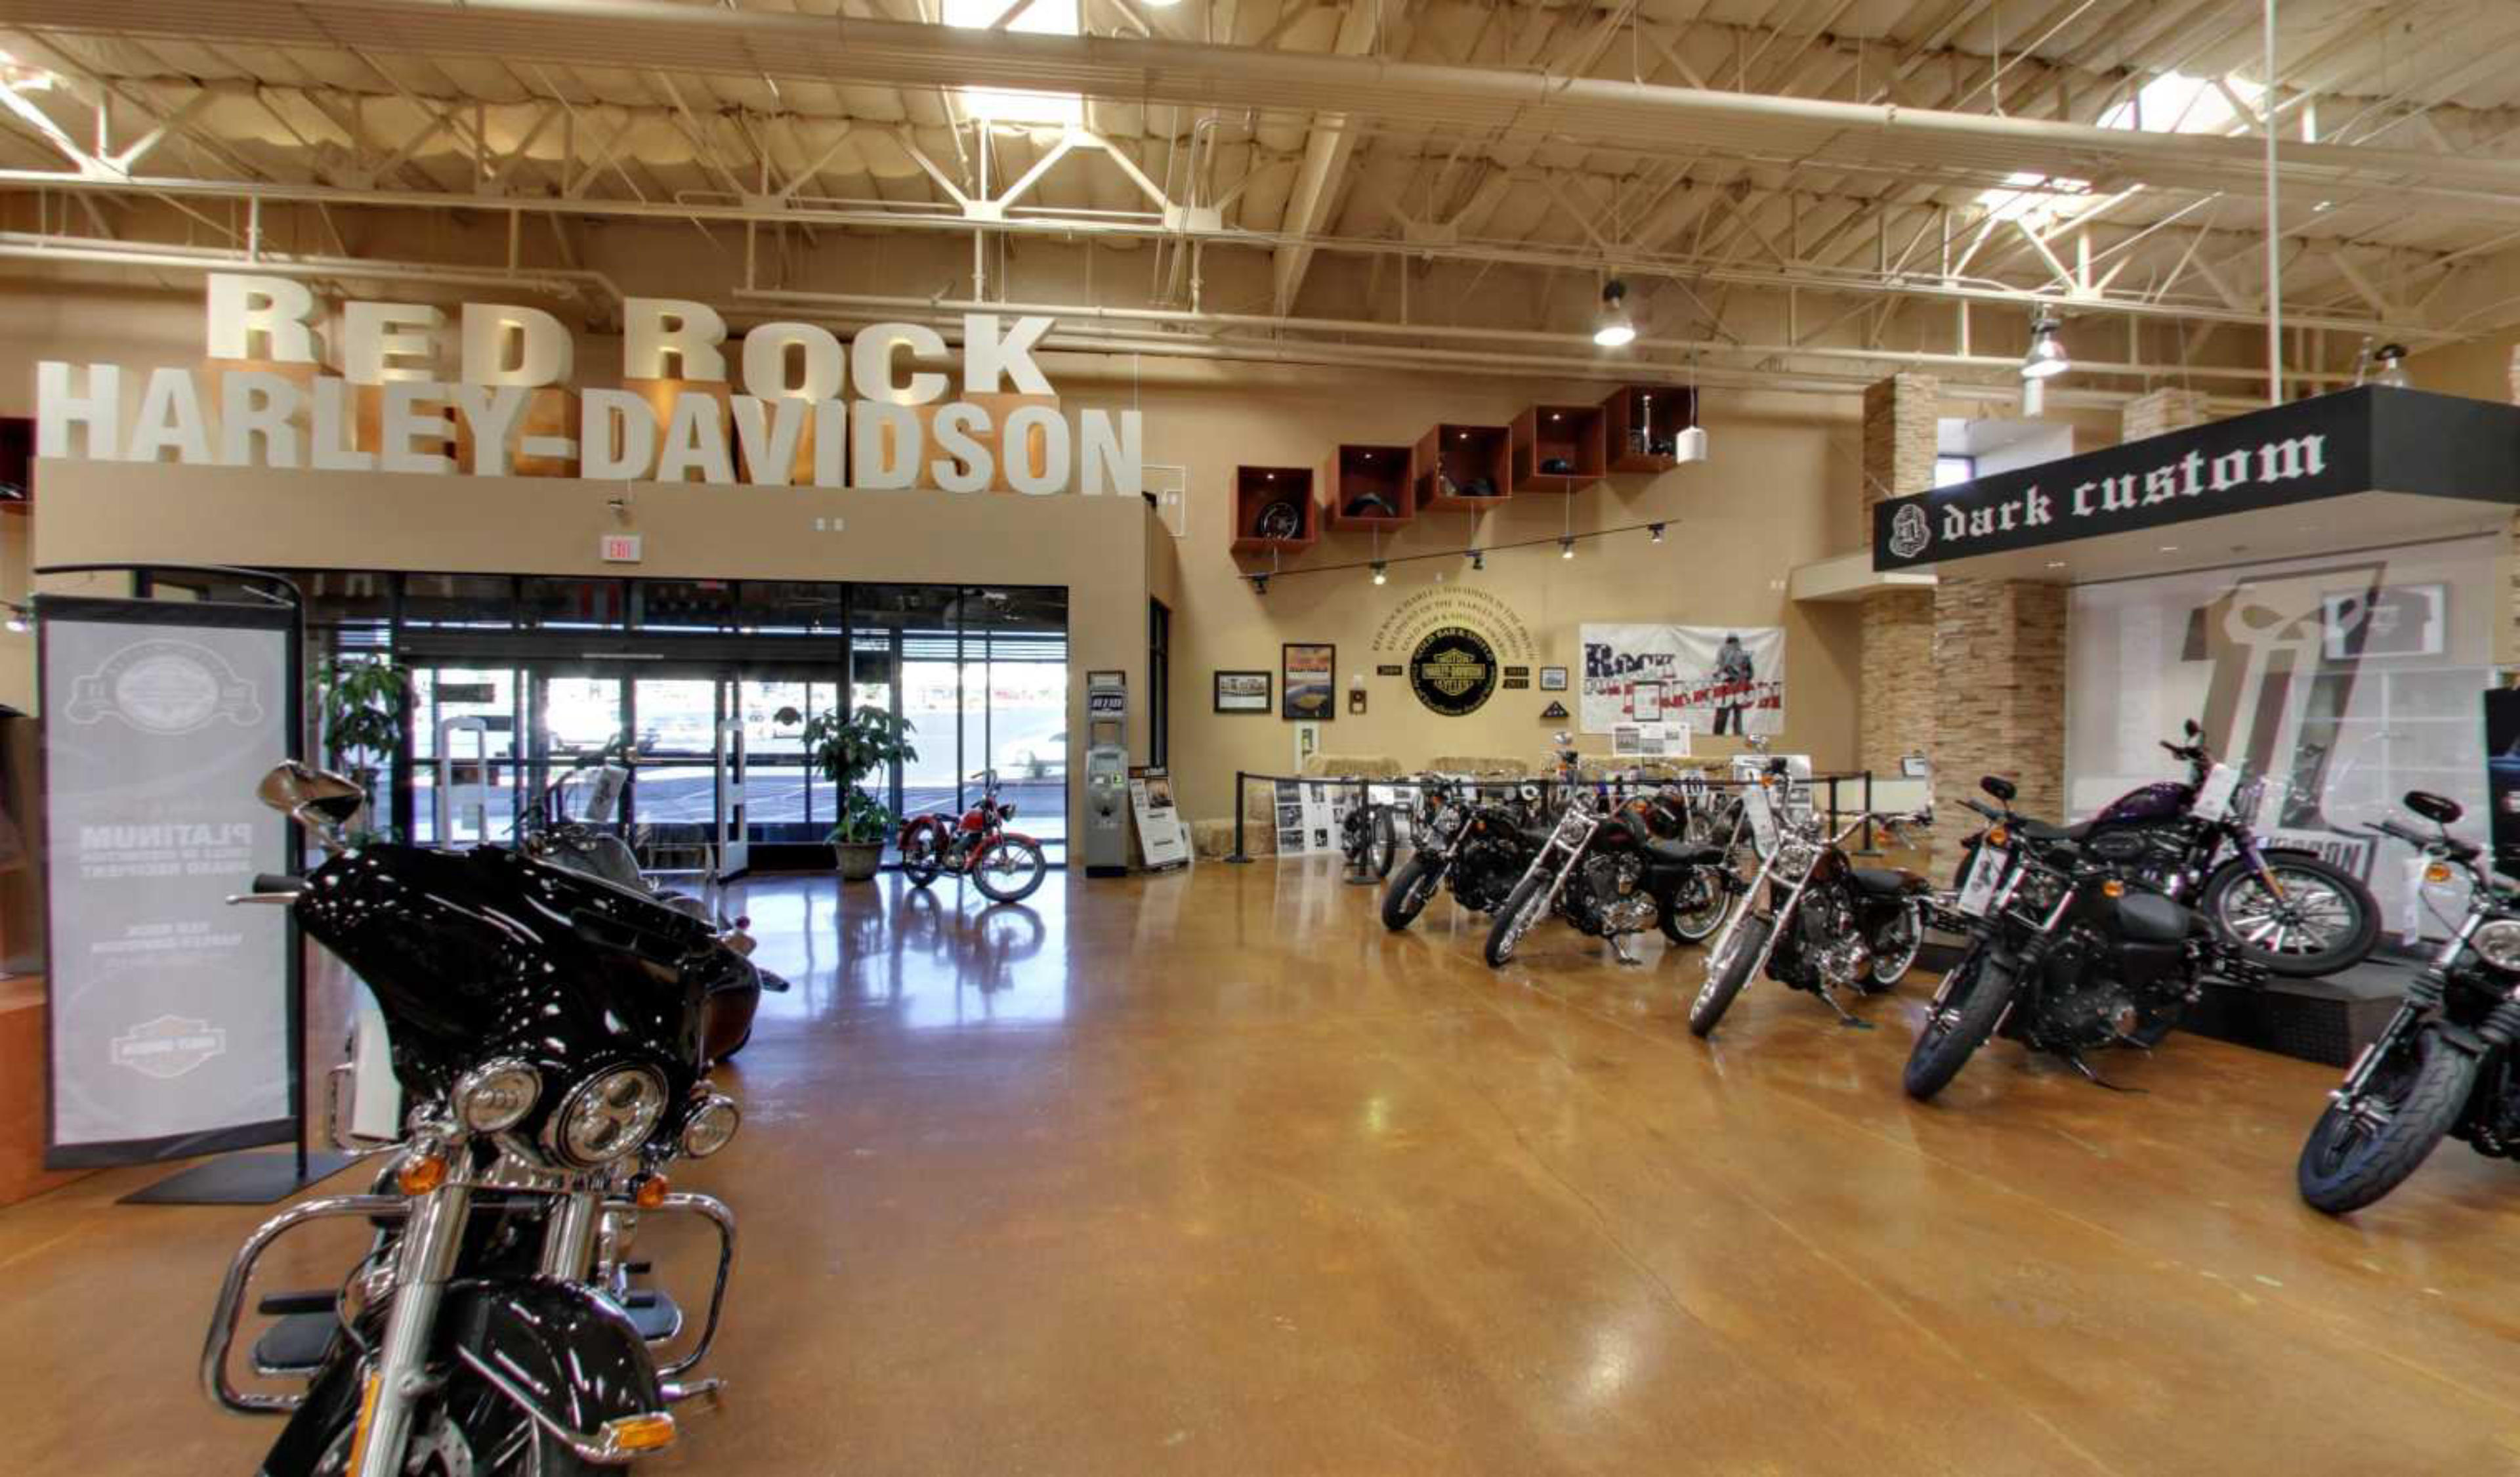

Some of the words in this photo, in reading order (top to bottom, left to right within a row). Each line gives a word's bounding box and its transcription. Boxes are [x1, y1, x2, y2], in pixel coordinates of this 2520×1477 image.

[207, 274, 573, 387] RED
[623, 297, 1058, 405] ROCK
[37, 360, 1143, 496] HARLEY-DAVIDSON
[1942, 485, 2052, 542] dark
[2072, 431, 2326, 518] custom
[610, 540, 631, 558] EXIT
